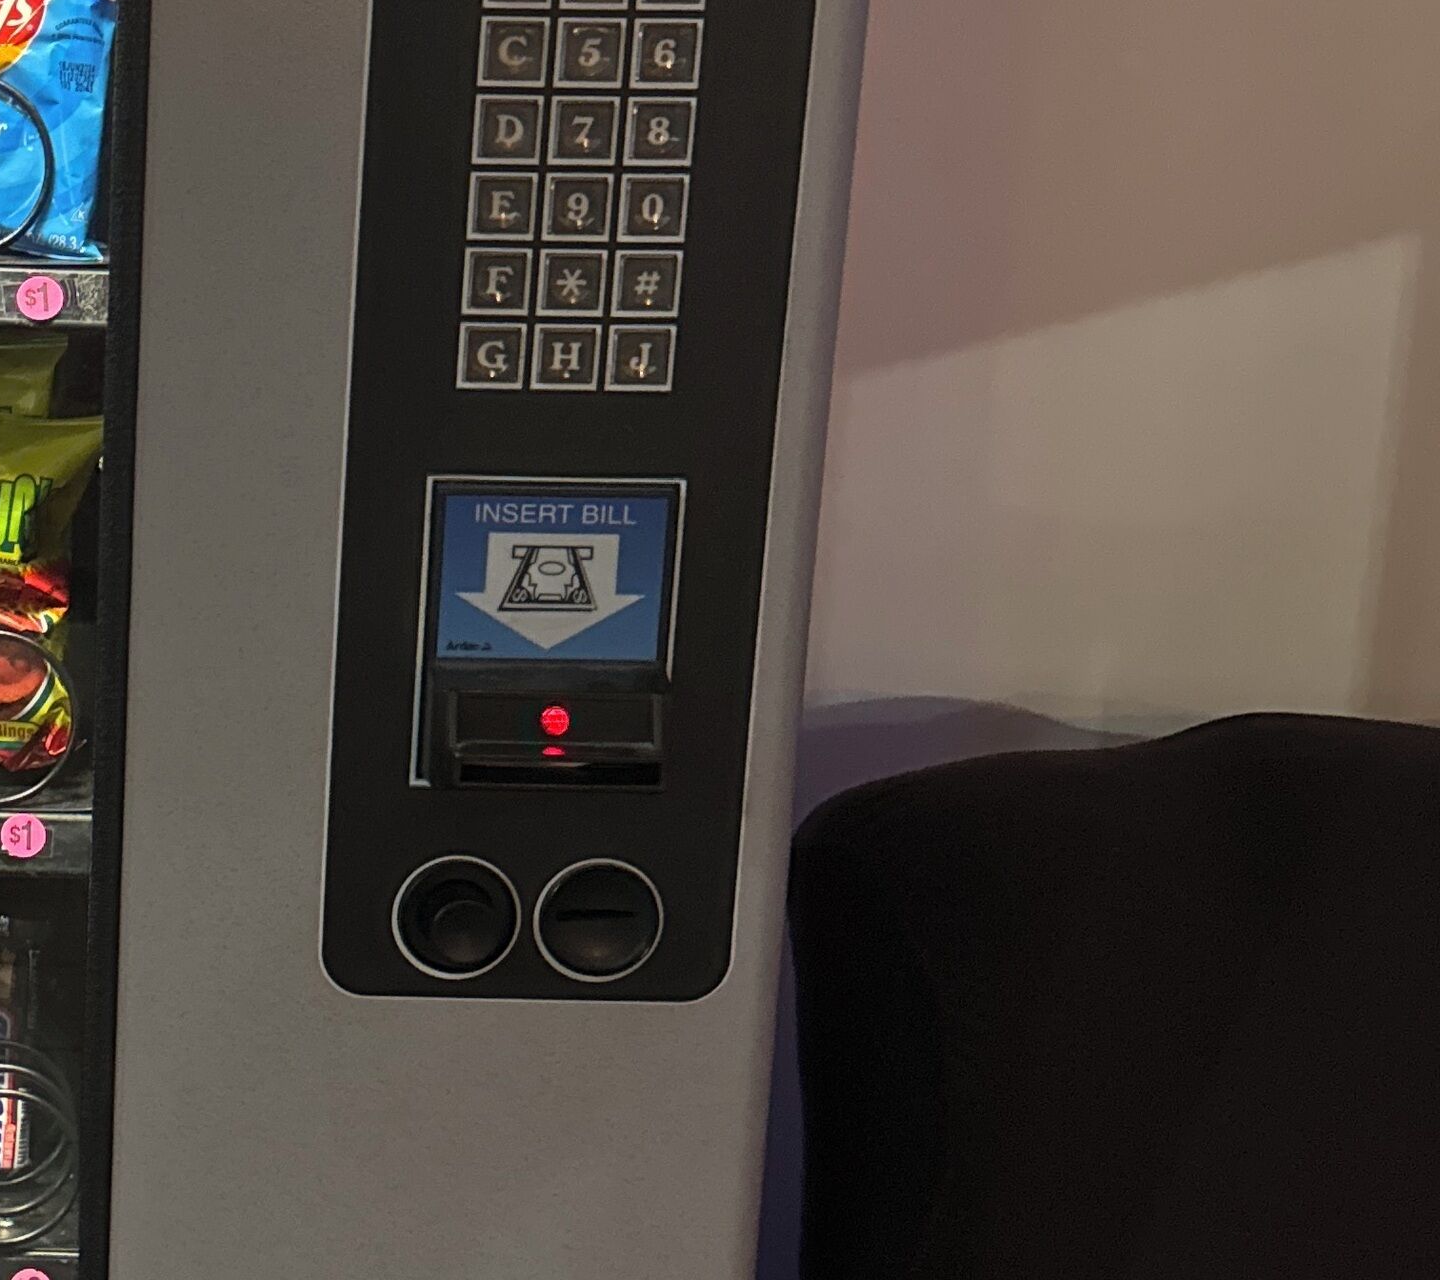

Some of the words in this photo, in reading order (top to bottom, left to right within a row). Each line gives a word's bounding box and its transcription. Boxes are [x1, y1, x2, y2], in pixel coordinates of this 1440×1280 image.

[498, 36, 527, 66] C
[578, 38, 601, 67] 5
[654, 39, 676, 67] 6
[495, 115, 524, 144] D
[572, 117, 594, 145] 7
[647, 117, 670, 145] 8
[489, 190, 516, 219] E
[567, 192, 589, 220] 9
[642, 193, 664, 221] 0
[485, 266, 513, 295] F
[634, 271, 660, 296] #
[25, 282, 49, 313] $1
[477, 341, 507, 371] G
[550, 342, 582, 370] H
[629, 342, 652, 370] J
[474, 503, 574, 524] INSERT
[581, 505, 637, 526] BILL
[9, 820, 33, 851] $1
